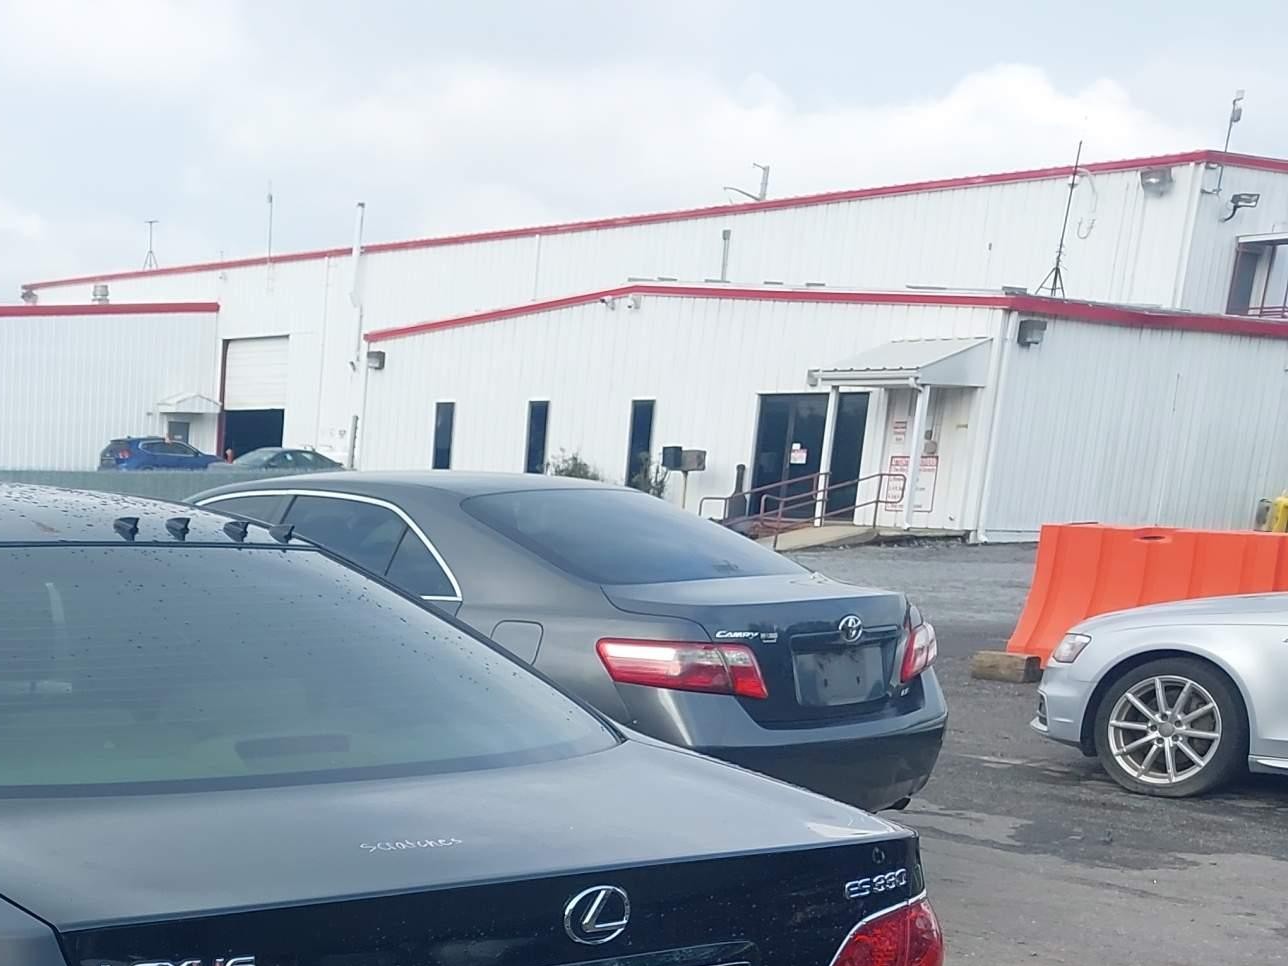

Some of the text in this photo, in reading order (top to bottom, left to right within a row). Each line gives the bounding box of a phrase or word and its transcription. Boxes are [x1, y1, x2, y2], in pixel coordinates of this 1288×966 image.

[716, 630, 758, 640] CAMRY
[845, 868, 907, 899] ES 330
